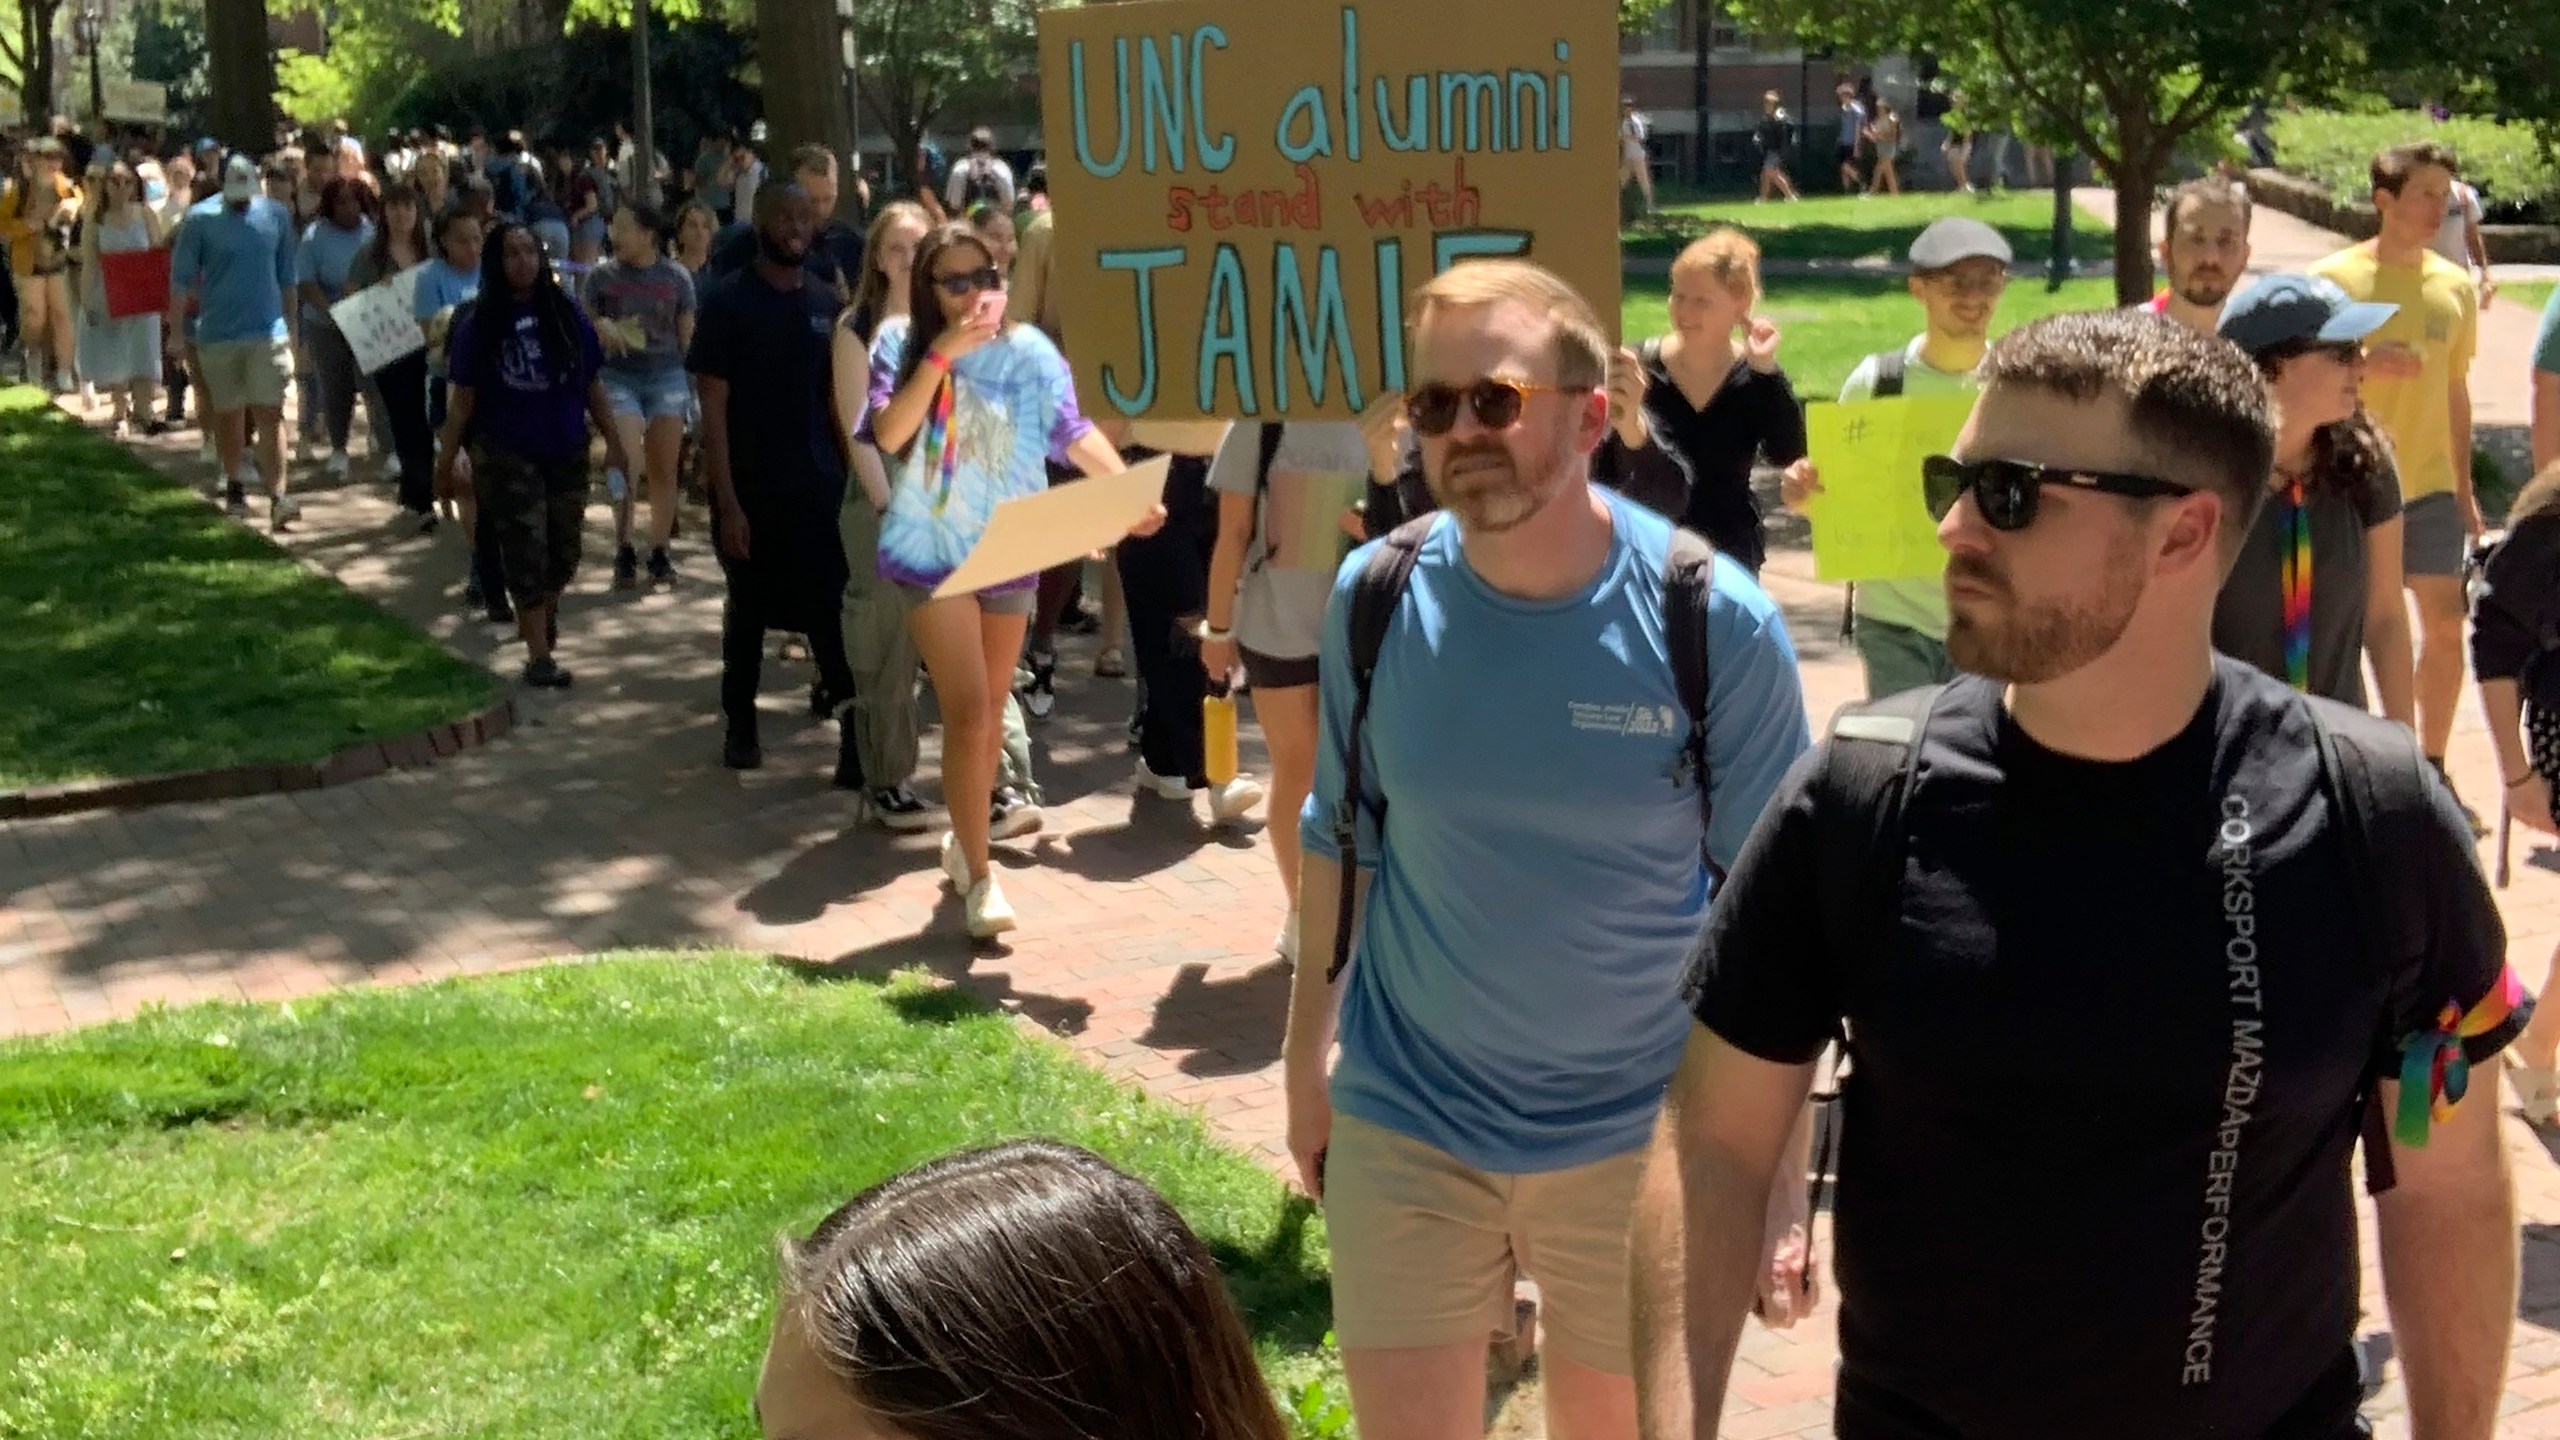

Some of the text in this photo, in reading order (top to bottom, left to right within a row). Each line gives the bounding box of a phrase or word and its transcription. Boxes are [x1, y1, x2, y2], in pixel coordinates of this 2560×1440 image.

[1070, 6, 1571, 178] UNC alumni
[1166, 156, 1480, 232] stand with
[1098, 228, 1534, 417] JAMI
[2182, 794, 2264, 1385] CORKSPORT MAZDA PERFORMANCE
